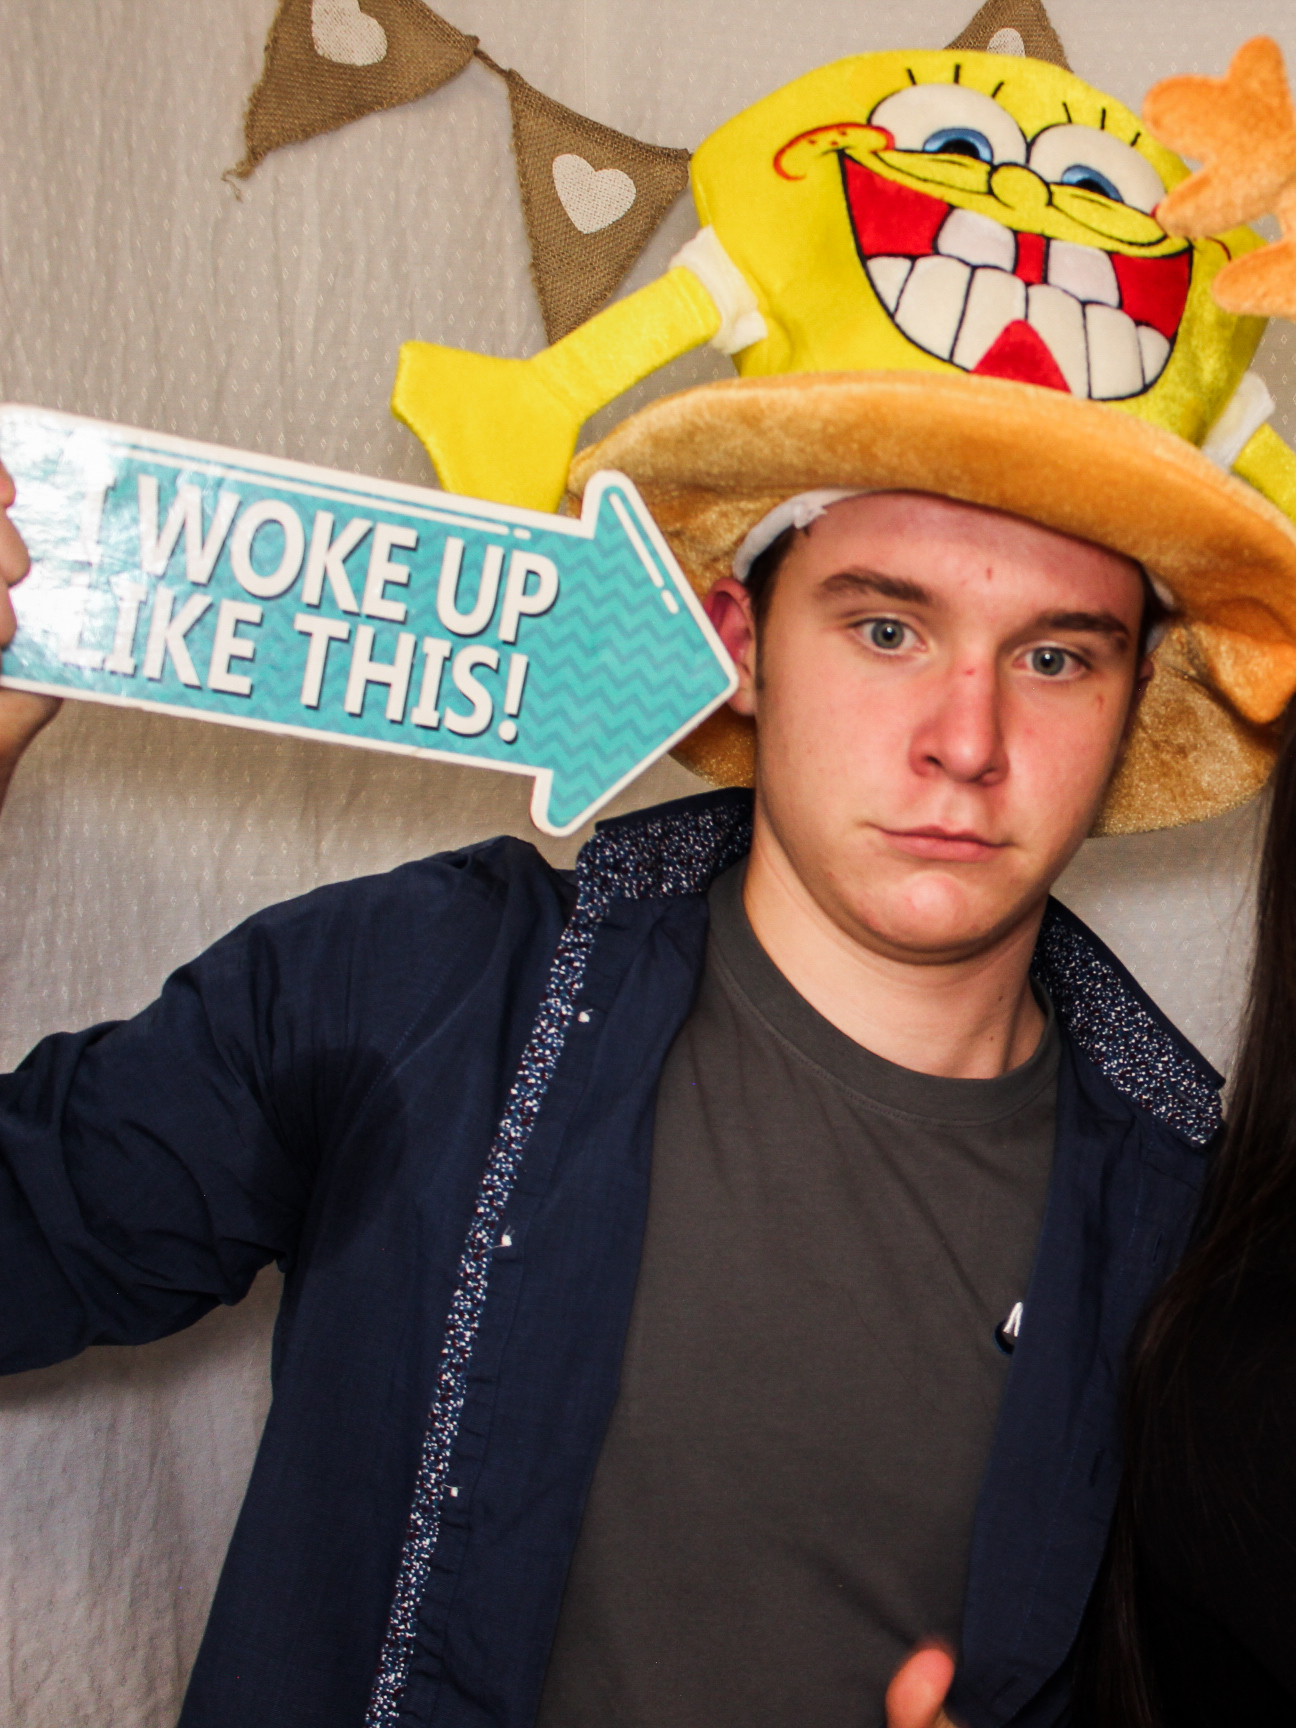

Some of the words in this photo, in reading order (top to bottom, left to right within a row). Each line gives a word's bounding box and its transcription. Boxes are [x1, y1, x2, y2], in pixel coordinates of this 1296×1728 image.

[137, 473, 419, 623] WOKE
[437, 537, 561, 644] UP
[59, 571, 265, 697] LIKE
[295, 612, 529, 744] THIS!
